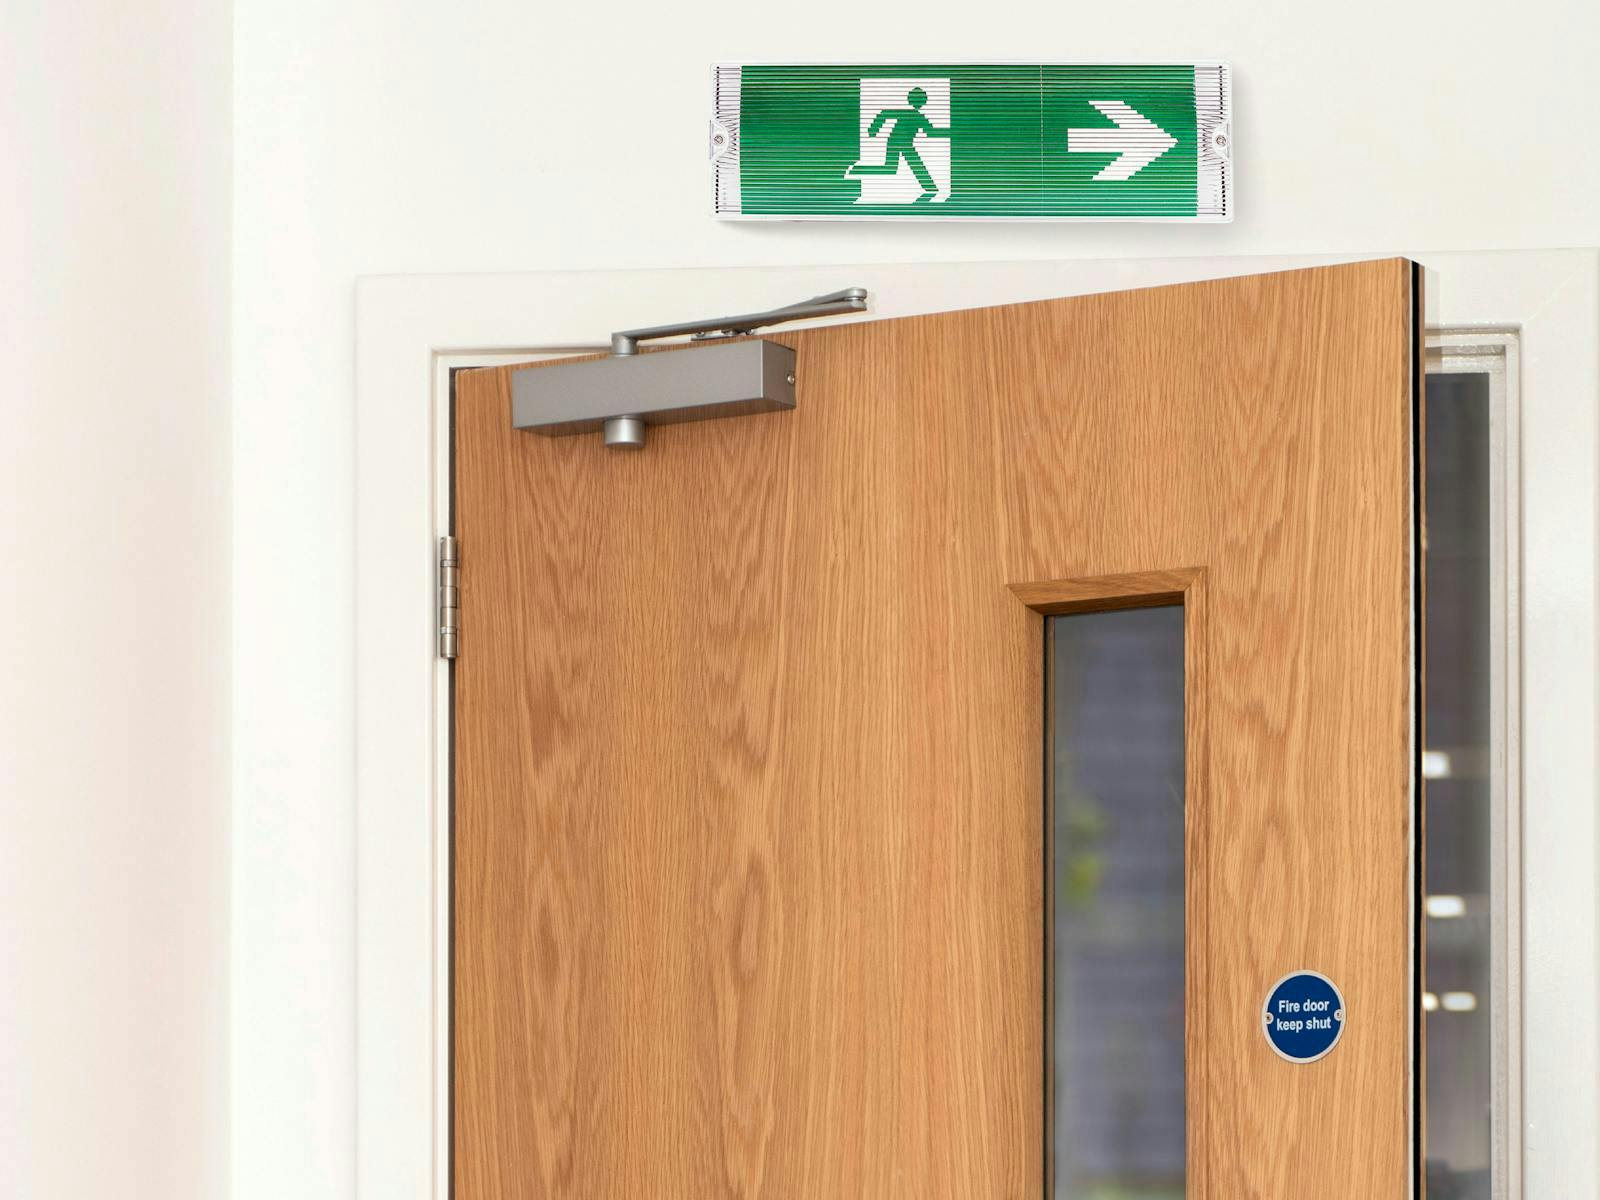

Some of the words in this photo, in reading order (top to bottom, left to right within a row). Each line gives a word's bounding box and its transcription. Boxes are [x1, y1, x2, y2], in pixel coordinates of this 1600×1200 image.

[1278, 1000, 1300, 1013] Fire
[1302, 999, 1330, 1012] door
[1276, 1018, 1303, 1033] keep
[1305, 1016, 1332, 1030] shut
